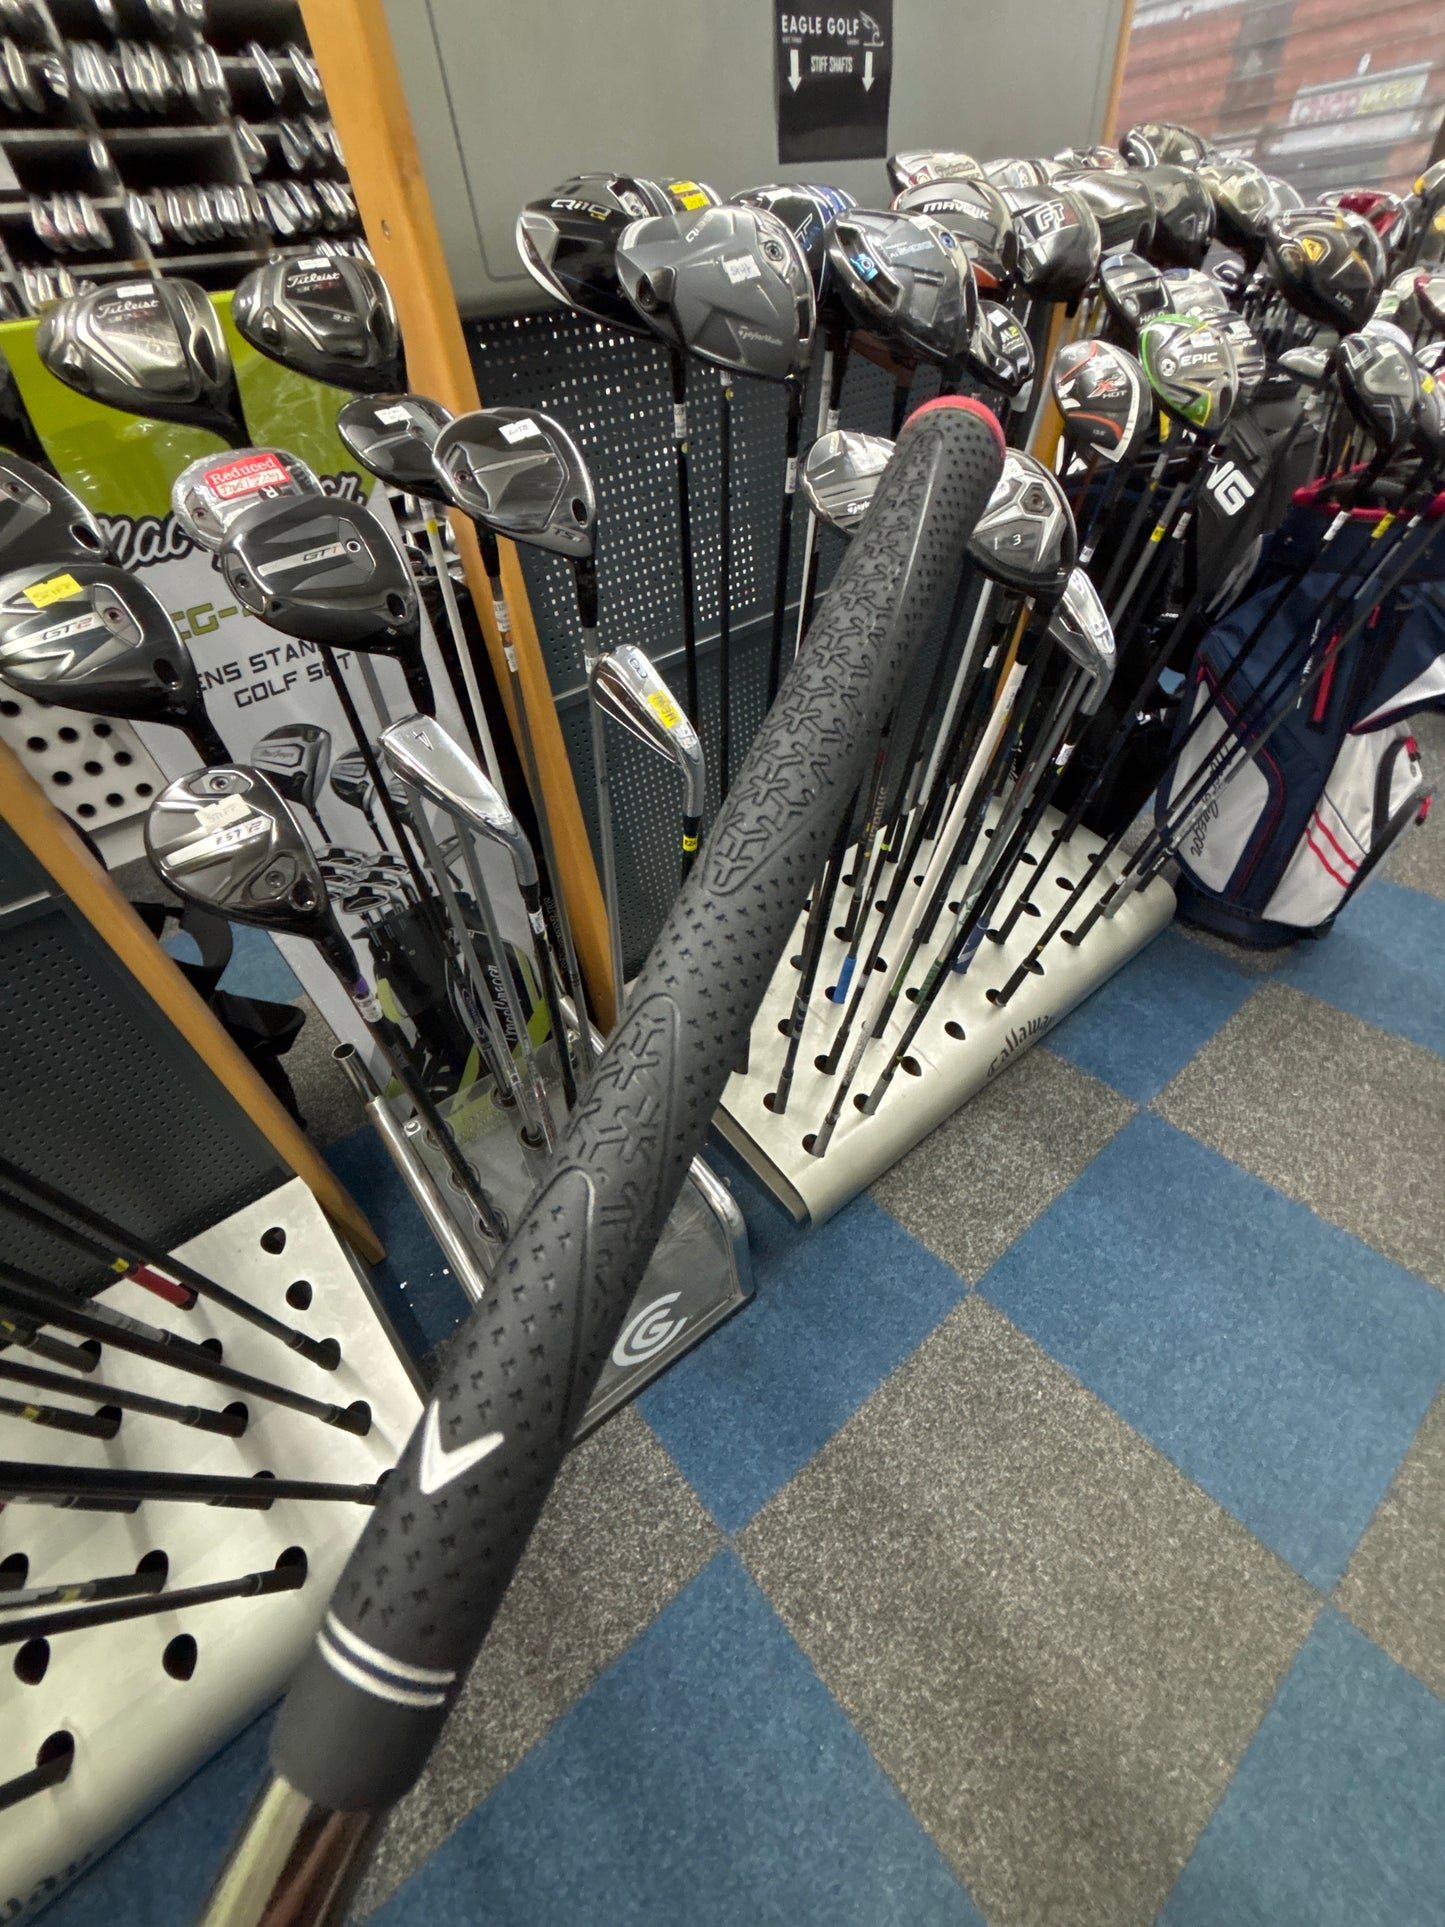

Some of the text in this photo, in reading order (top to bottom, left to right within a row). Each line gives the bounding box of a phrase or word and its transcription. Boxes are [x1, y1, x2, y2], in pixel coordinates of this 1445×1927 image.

[781, 14, 859, 36] EAGLE GOLF
[810, 55, 853, 73] STIFF SHAFTS
[285, 271, 341, 289] Titleist
[95, 299, 160, 319] Titleist
[1180, 352, 1219, 367] EPIC
[1102, 390, 1127, 399] HOT
[209, 457, 278, 485] Reduced
[1011, 533, 1023, 547] 3
[303, 545, 339, 562] GT1
[42, 616, 96, 642] GT2
[248, 639, 317, 674] STAN
[233, 670, 298, 709] GOLF
